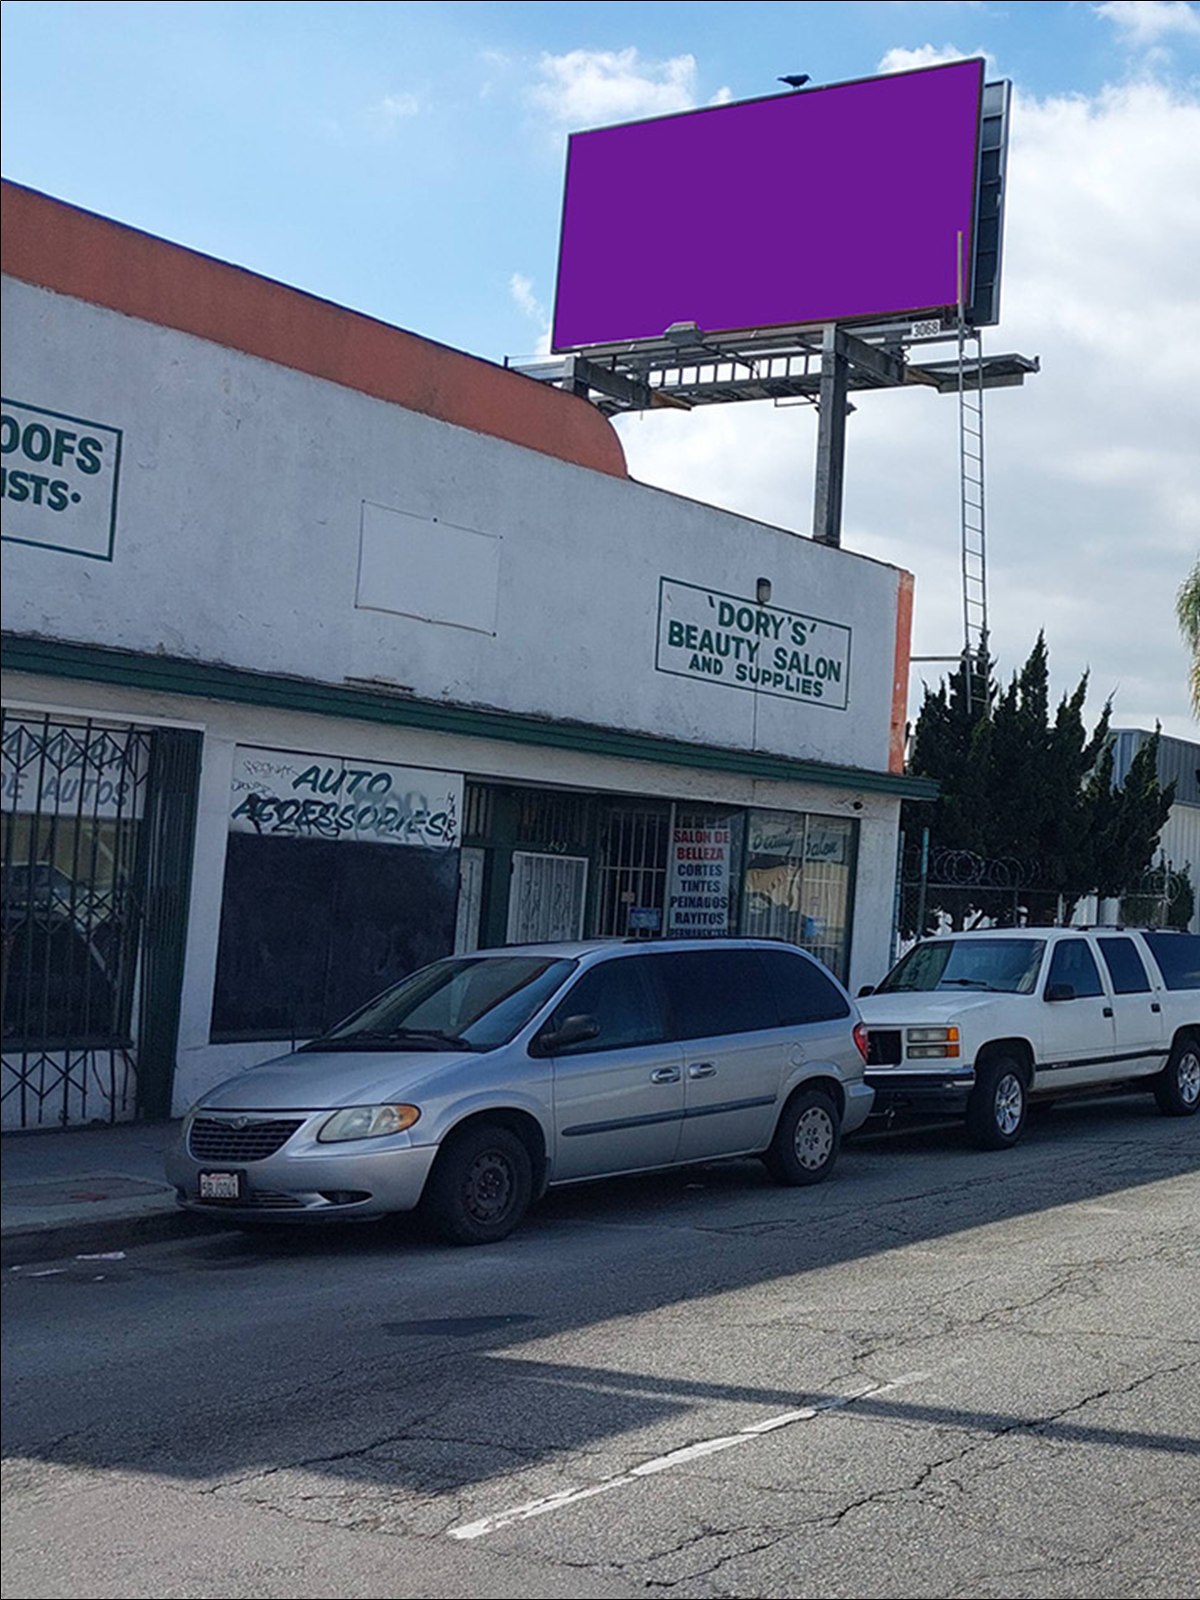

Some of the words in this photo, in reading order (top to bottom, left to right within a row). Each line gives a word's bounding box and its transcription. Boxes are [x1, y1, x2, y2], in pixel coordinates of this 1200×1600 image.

[913, 320, 939, 338] 3068
[1, 415, 103, 475] OOFS
[668, 620, 760, 663] BEAUTY
[773, 647, 842, 682] SALON
[689, 654, 723, 675] AND
[735, 664, 823, 698] SUPPLIES
[292, 765, 392, 796] AUTO
[41, 776, 130, 806] AUTOS
[674, 830, 711, 843] SALON
[714, 830, 730, 843] DE
[677, 847, 724, 860] BELLEZA
[678, 864, 723, 877] CORTES
[681, 880, 721, 893] TINTES
[671, 896, 728, 909] PEINADOS
[675, 912, 725, 925] RAYITOS
